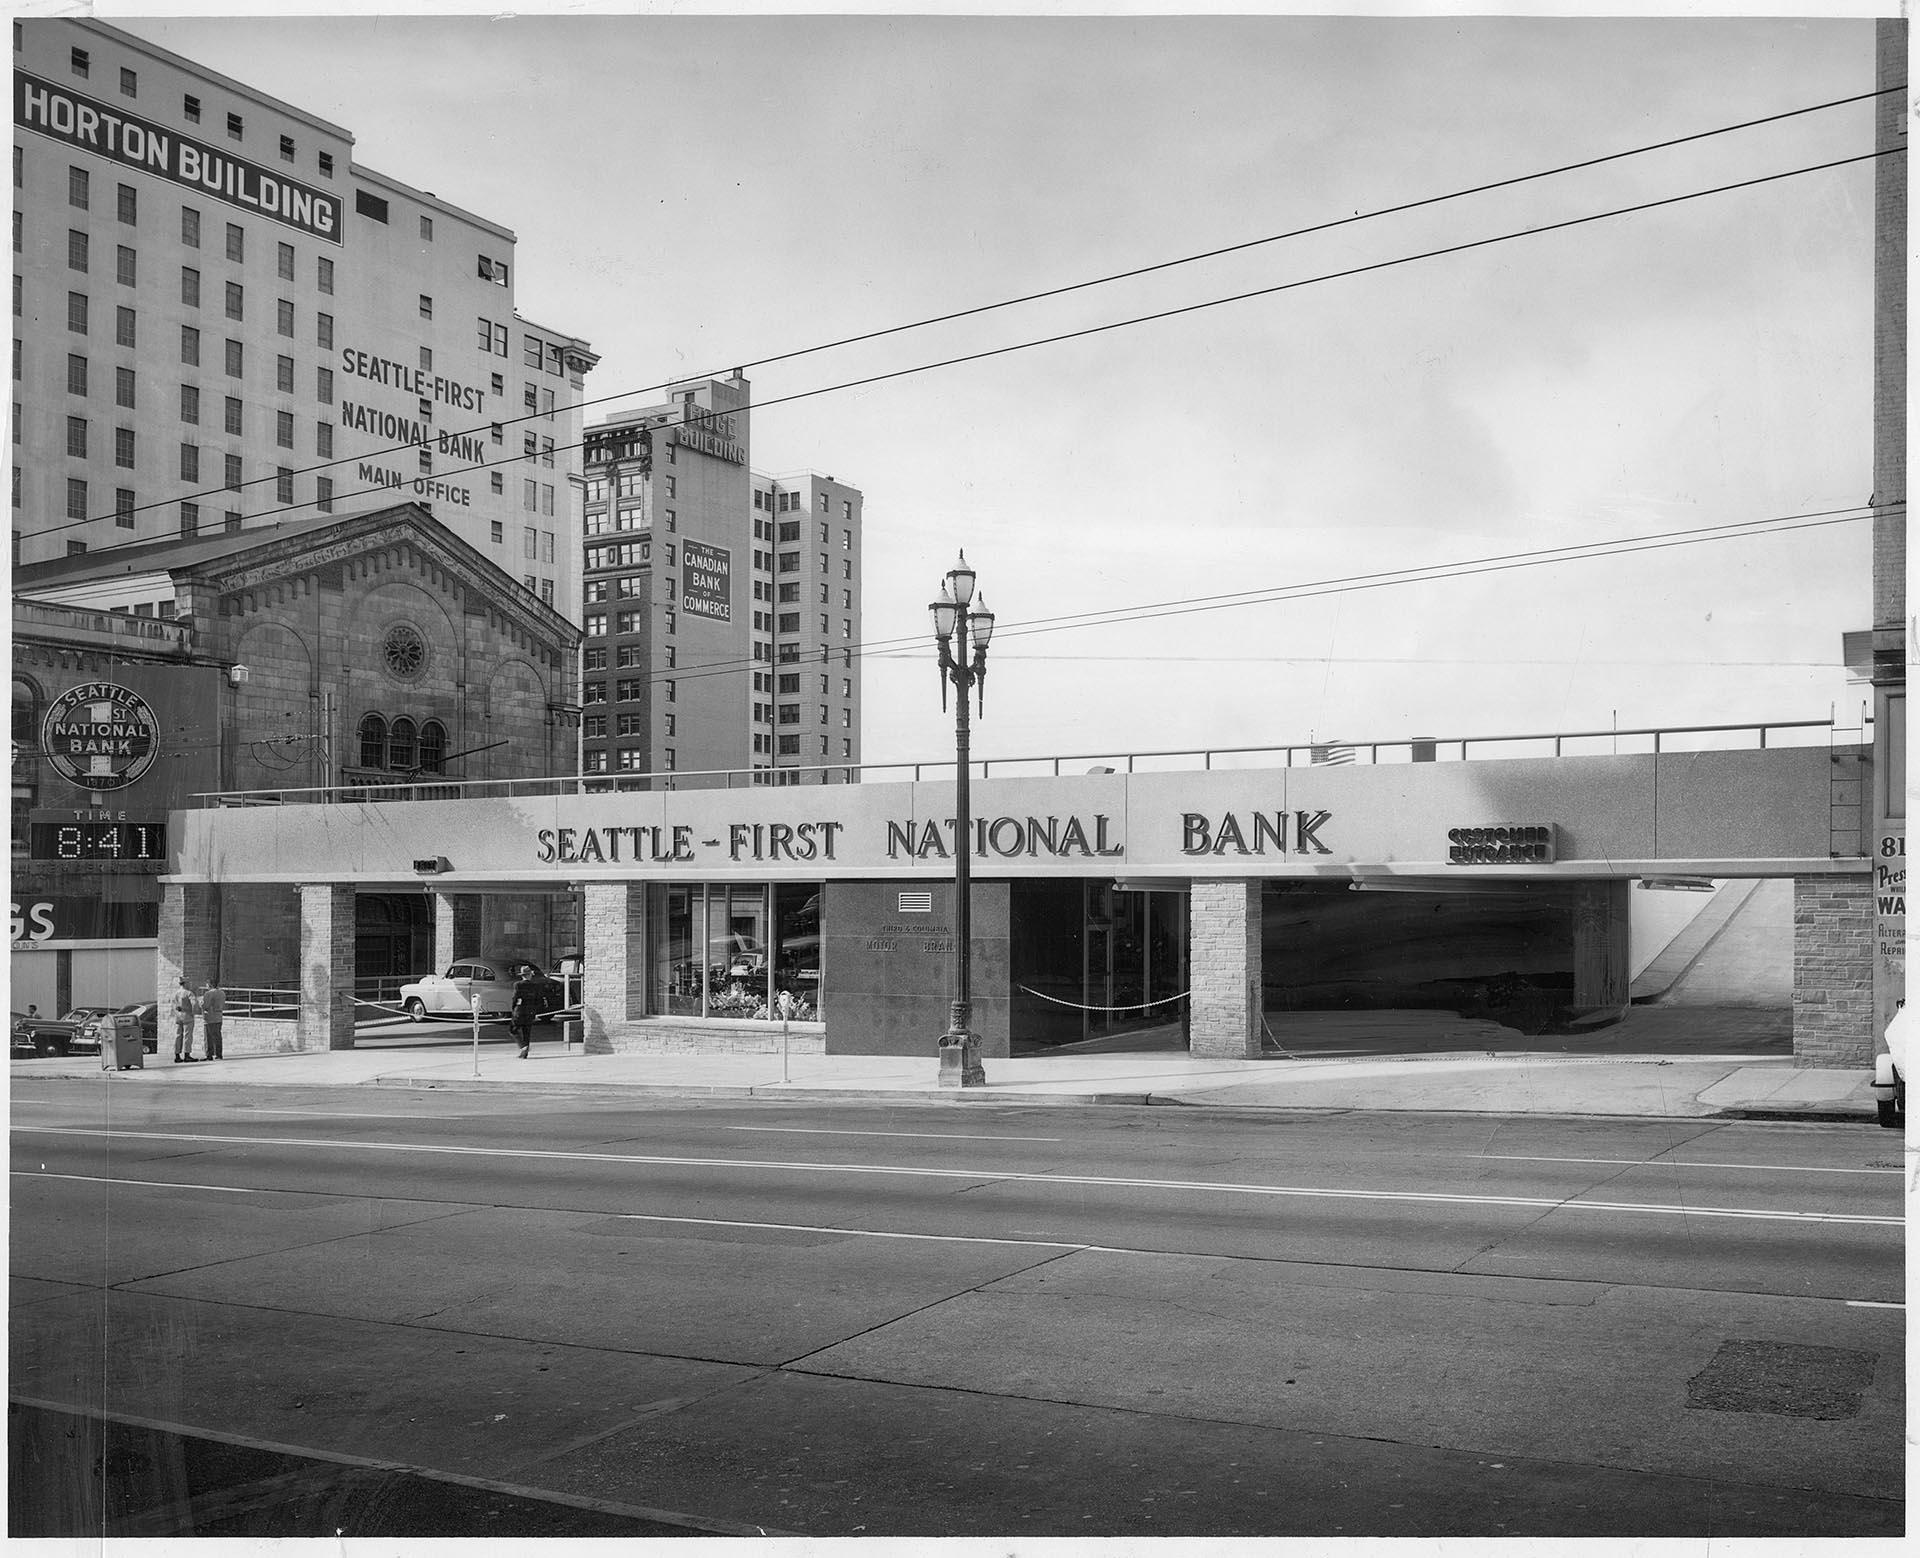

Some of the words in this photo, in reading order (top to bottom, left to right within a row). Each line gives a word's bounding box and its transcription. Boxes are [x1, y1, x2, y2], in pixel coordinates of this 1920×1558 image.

[24, 83, 169, 170] HORTON
[179, 143, 334, 233] BUILDING
[342, 348, 485, 414] SEATTLE-FIRST
[342, 400, 431, 450] NATIONAL
[438, 429, 485, 465] BANK
[679, 426, 746, 466] BUILDING
[359, 462, 402, 490] MAIN
[413, 478, 470, 506] OFFICE
[701, 546, 714, 556] THE
[684, 552, 728, 575] CANADIAN
[692, 572, 721, 591] BANK
[702, 590, 711, 598] OF
[683, 595, 730, 618] COMMERCE
[65, 685, 138, 707] SEATTLE
[55, 722, 148, 737] NATIONAL
[70, 739, 131, 755] BANK
[74, 810, 126, 821] TIME
[58, 827, 150, 858] 8:41
[886, 814, 1125, 859] NATIONAL
[1180, 810, 1334, 856] BANK
[1447, 826, 1550, 845] CUSTOMER
[1449, 844, 1546, 862] ENTRANCE
